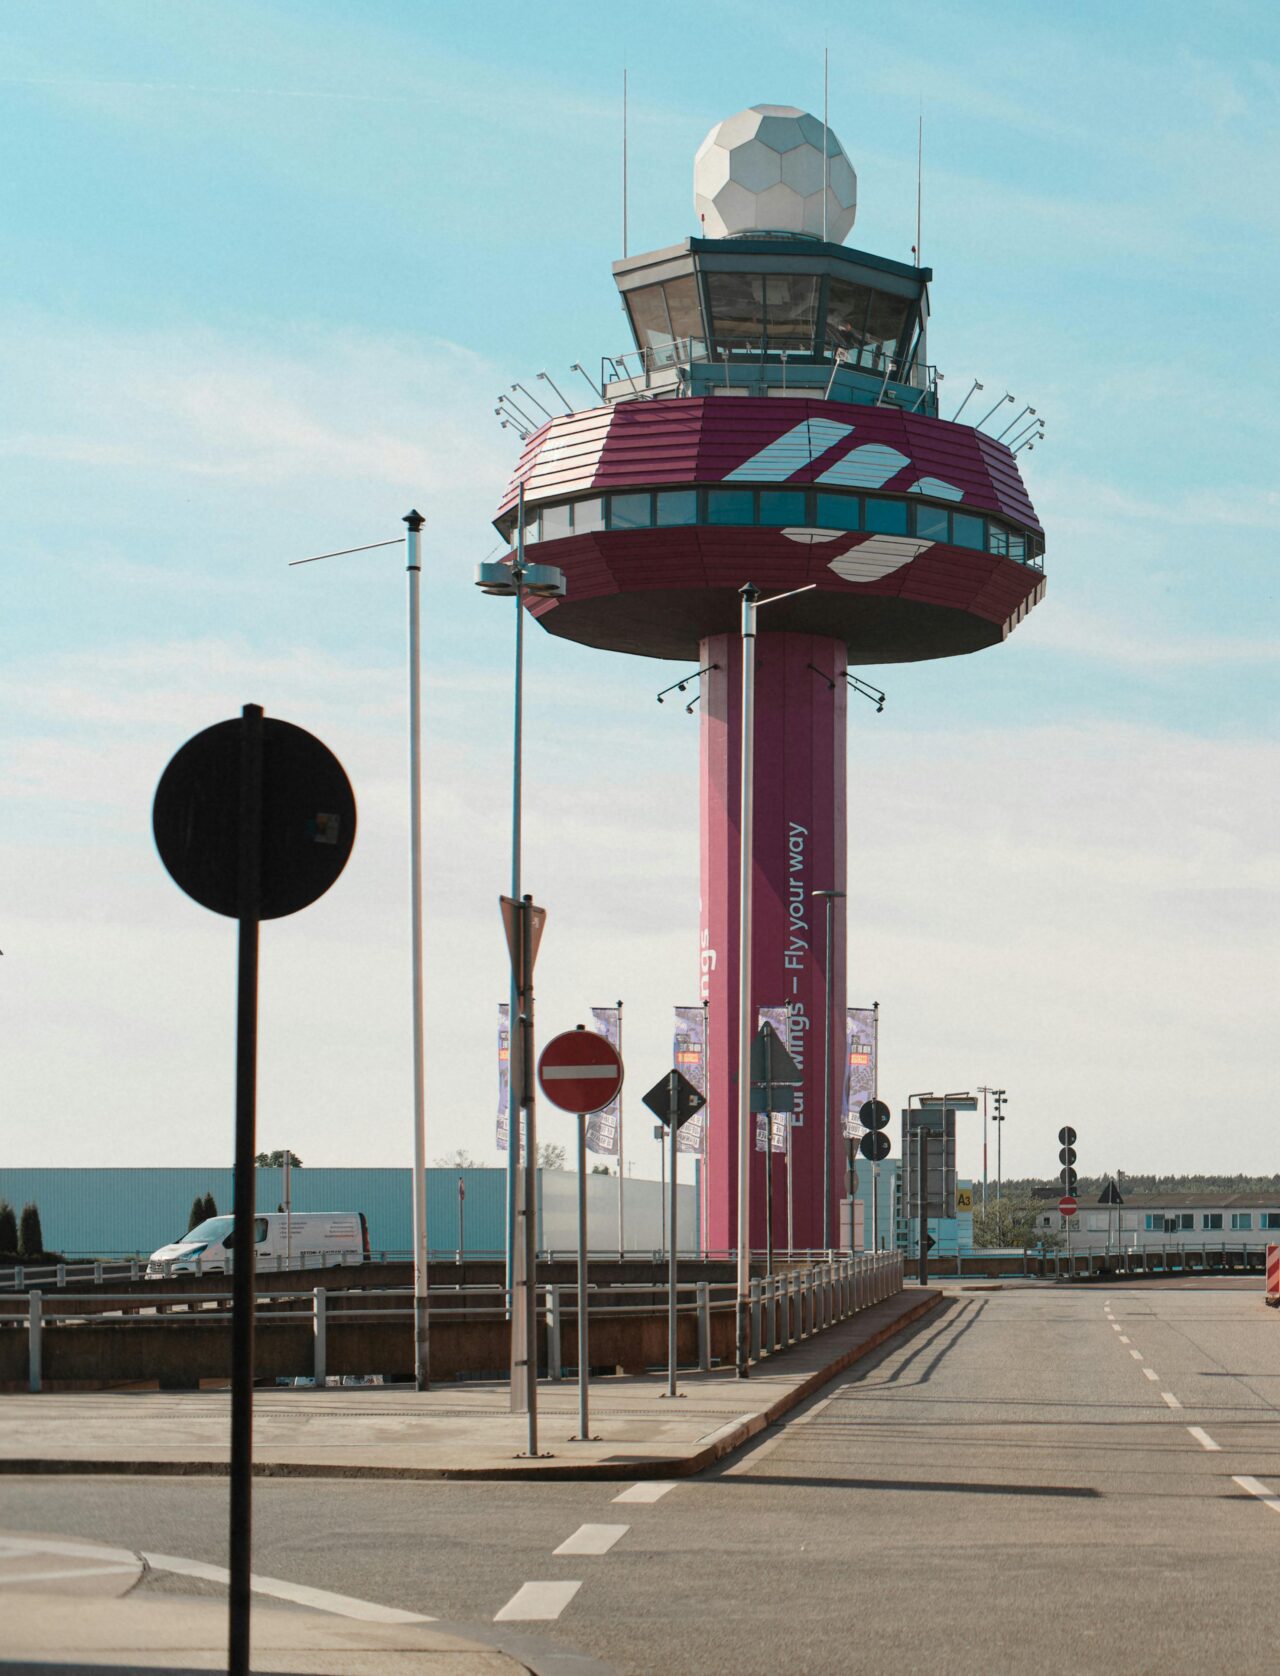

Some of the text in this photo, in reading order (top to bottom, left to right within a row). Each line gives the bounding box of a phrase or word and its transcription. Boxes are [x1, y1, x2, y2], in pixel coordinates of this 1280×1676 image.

[789, 821, 808, 872] way
[789, 877, 808, 930] your
[784, 936, 808, 969] Fly
[958, 1194, 971, 1206] A3
